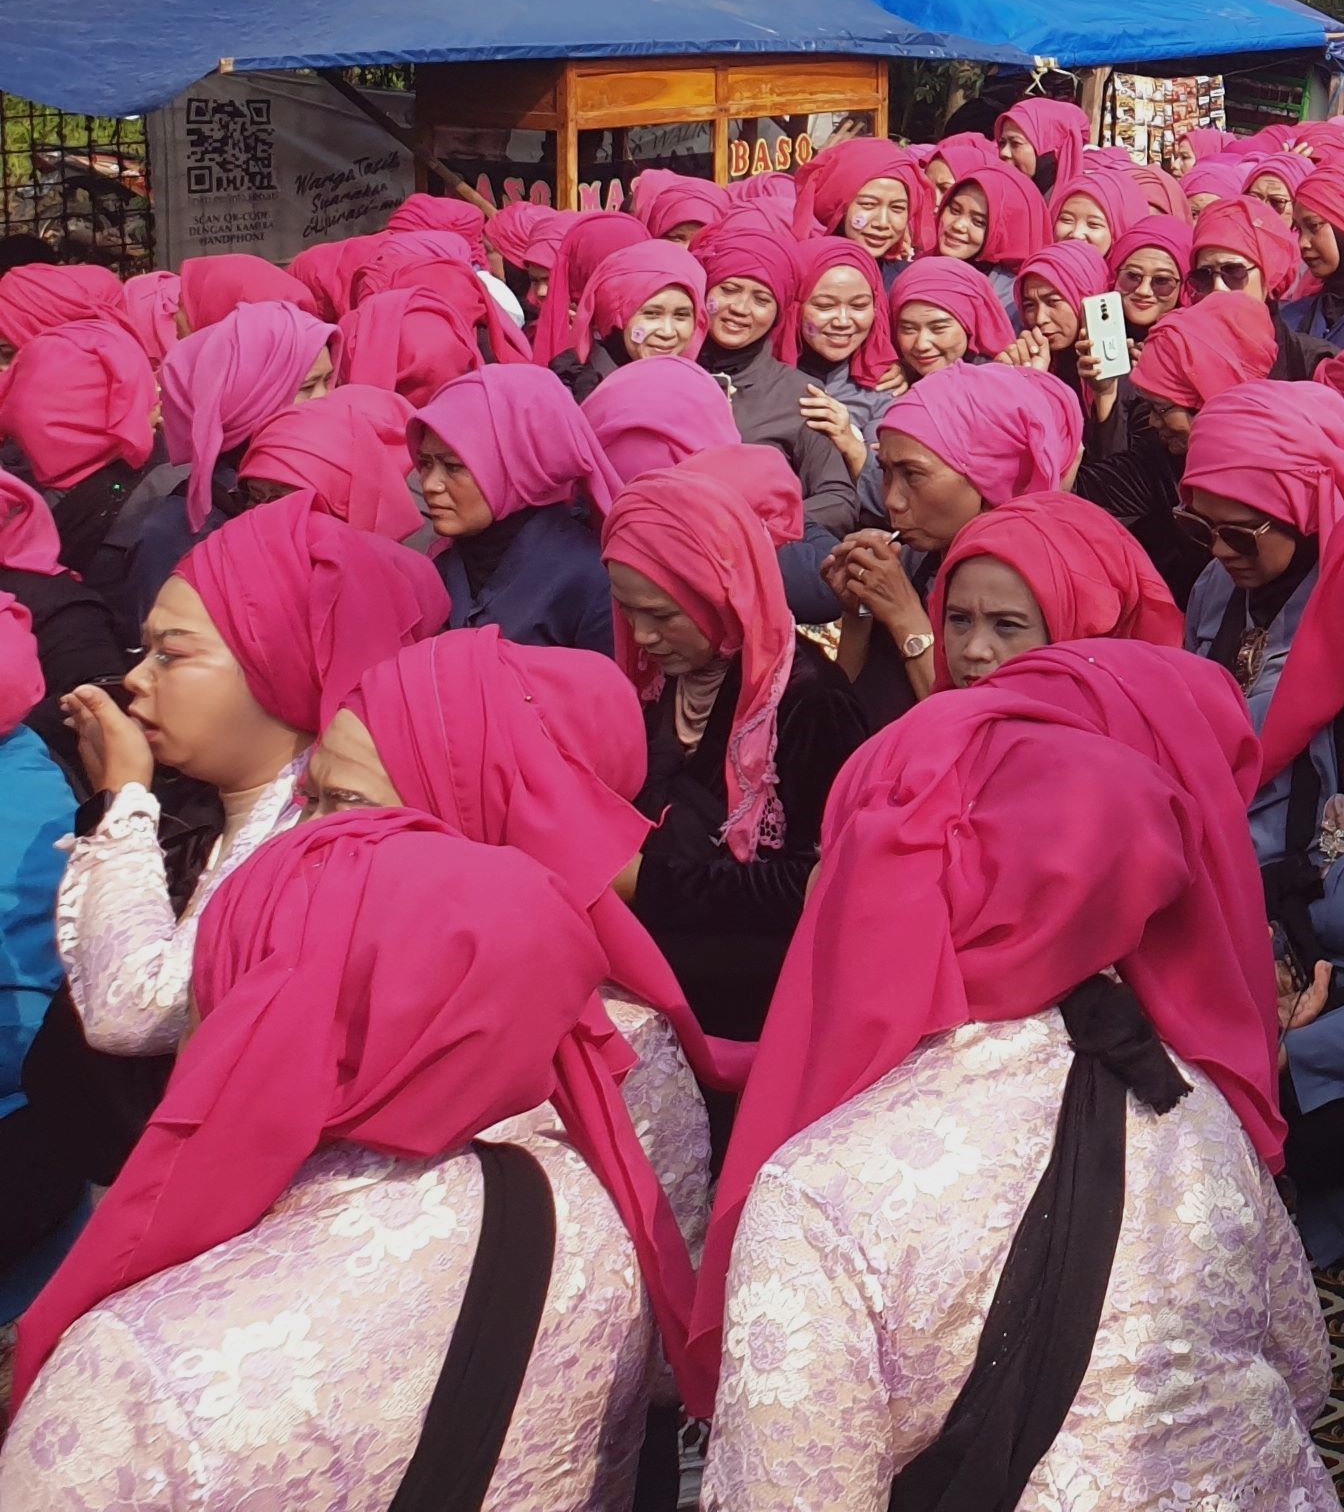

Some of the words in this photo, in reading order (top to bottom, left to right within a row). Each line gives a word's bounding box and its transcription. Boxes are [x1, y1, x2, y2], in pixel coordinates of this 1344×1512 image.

[731, 133, 813, 176] BASO
[295, 171, 356, 196] Warga
[189, 224, 234, 237] DENGAN
[236, 220, 274, 232] KAMERA
[192, 215, 221, 225] SCAN
